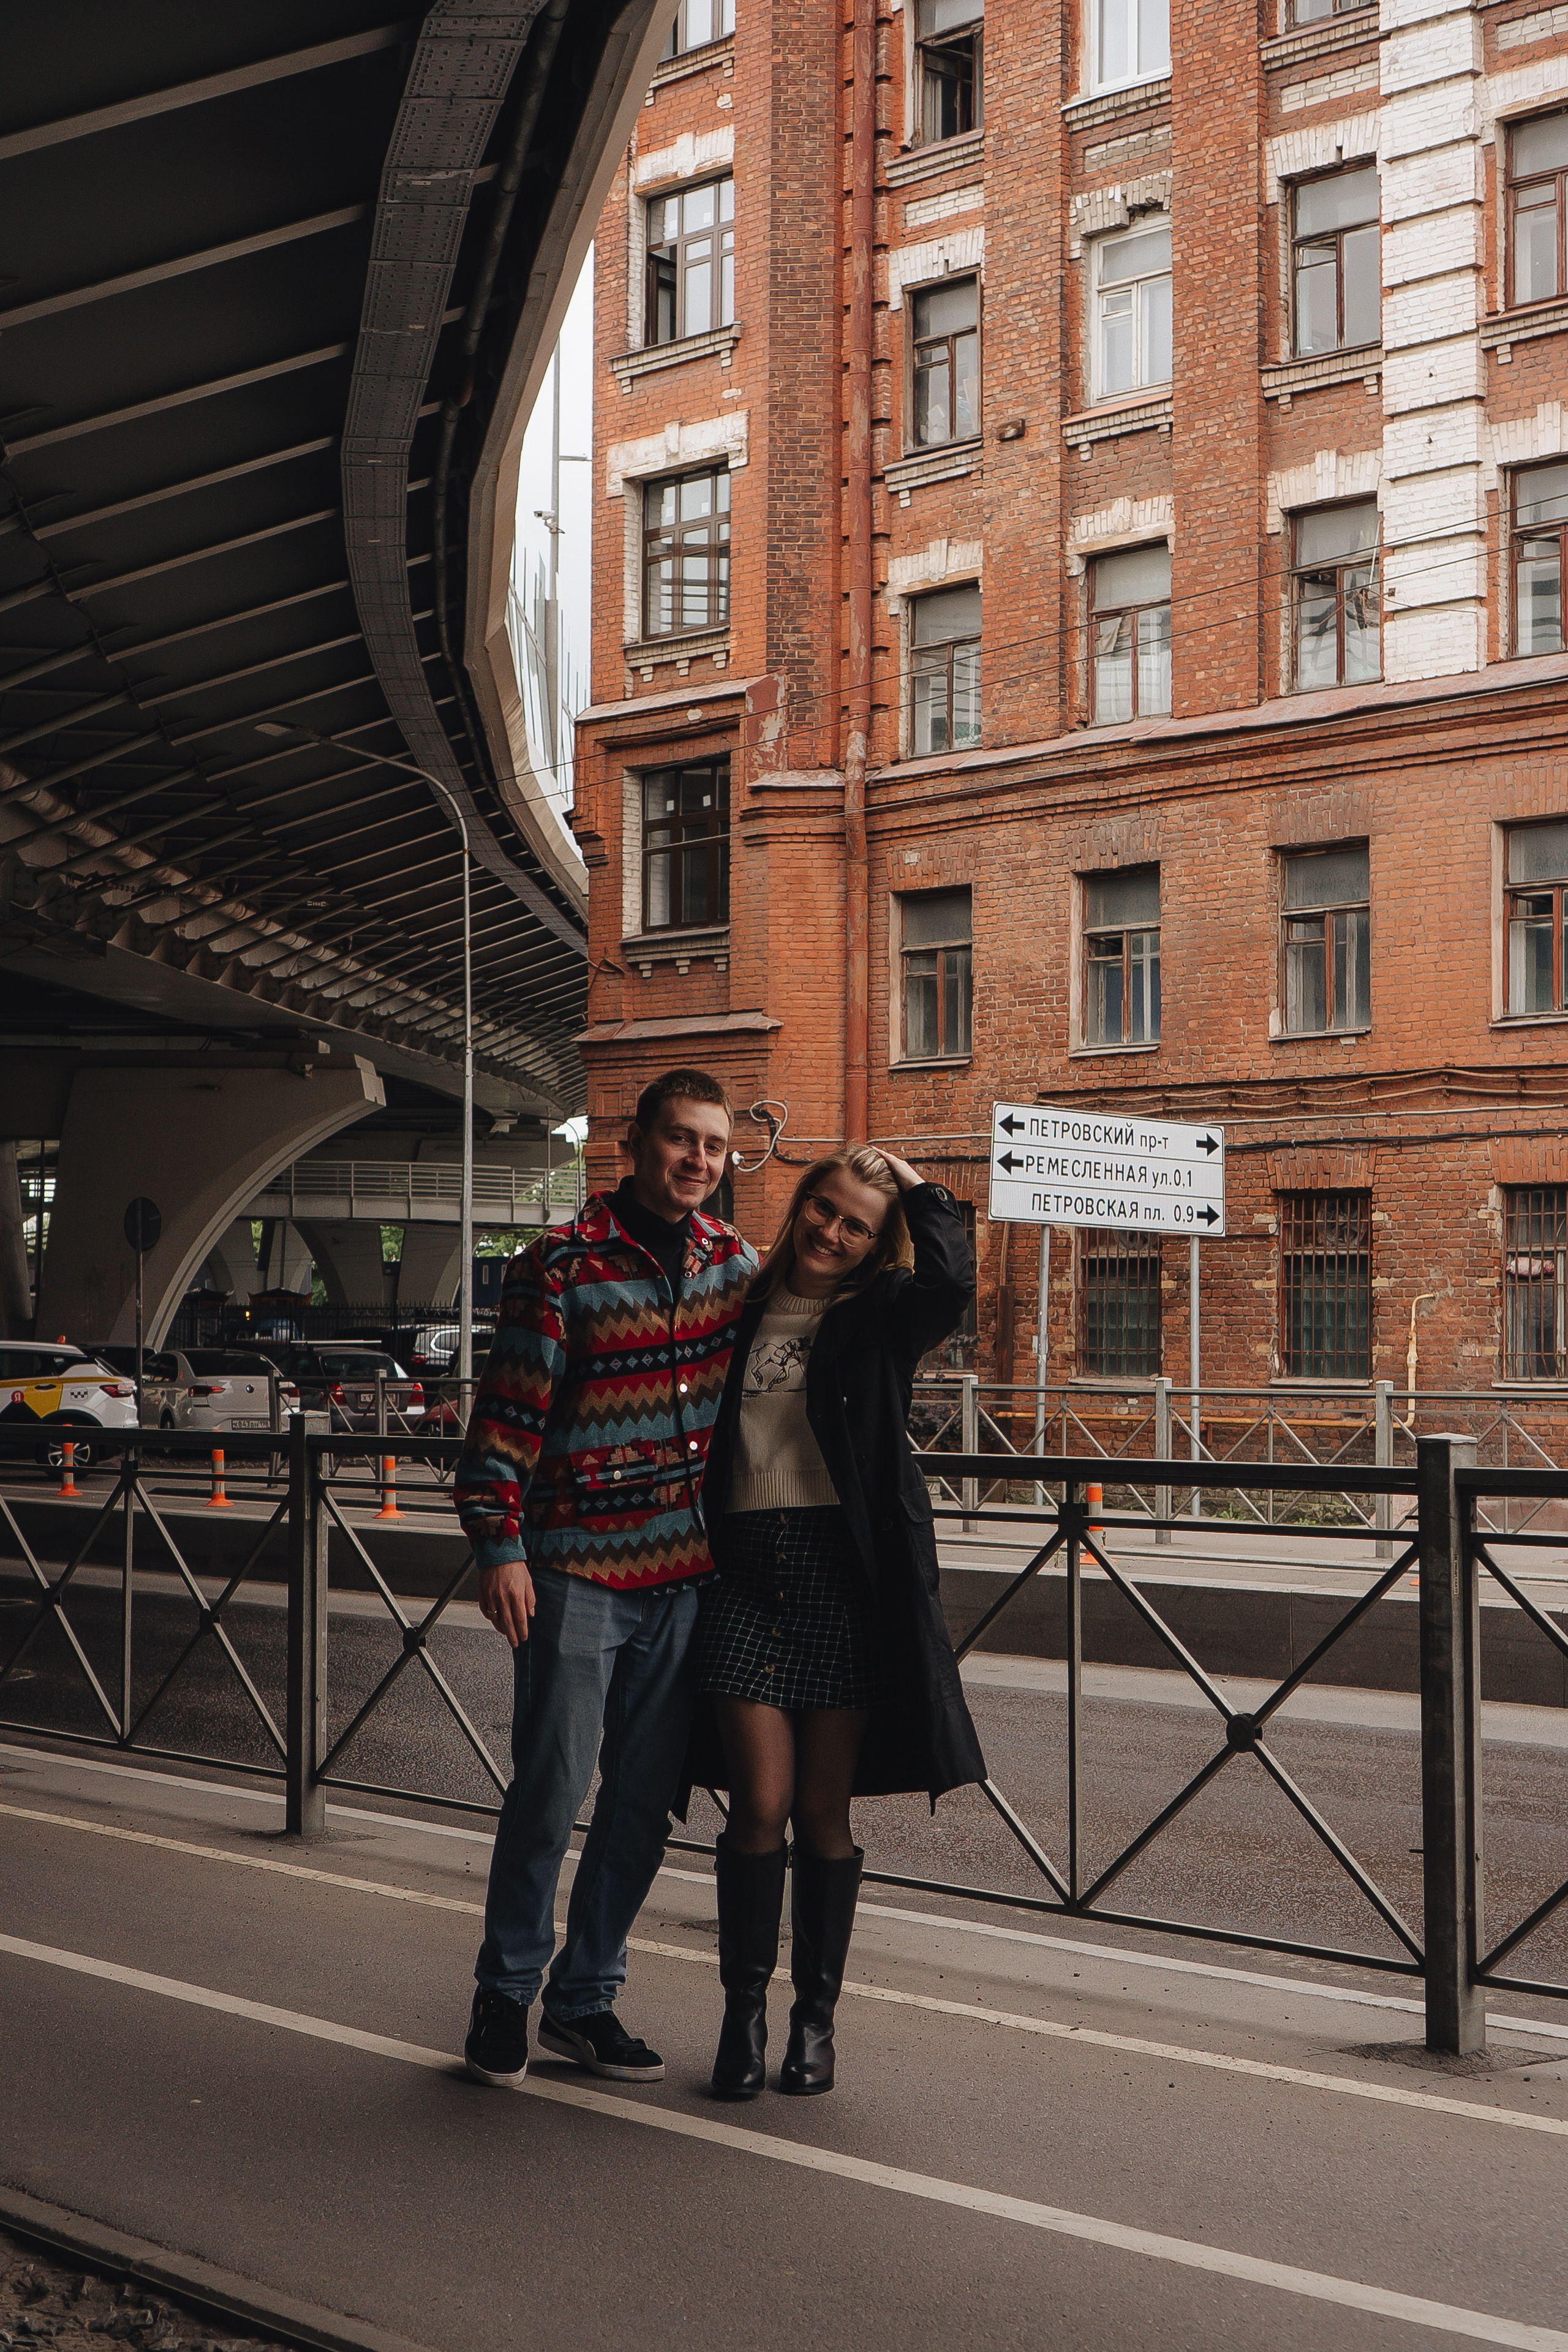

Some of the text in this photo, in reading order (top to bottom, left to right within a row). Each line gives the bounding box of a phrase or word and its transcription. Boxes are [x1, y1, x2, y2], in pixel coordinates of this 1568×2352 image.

[1030, 1118, 1169, 1153] ПЕТРОВСКИЙ пр-т
[1025, 1155, 1147, 1183] РЕМЕСЛЕННАЯ
[1031, 1193, 1194, 1223] ПЕТРОВСКАЯ пл. 0,9
